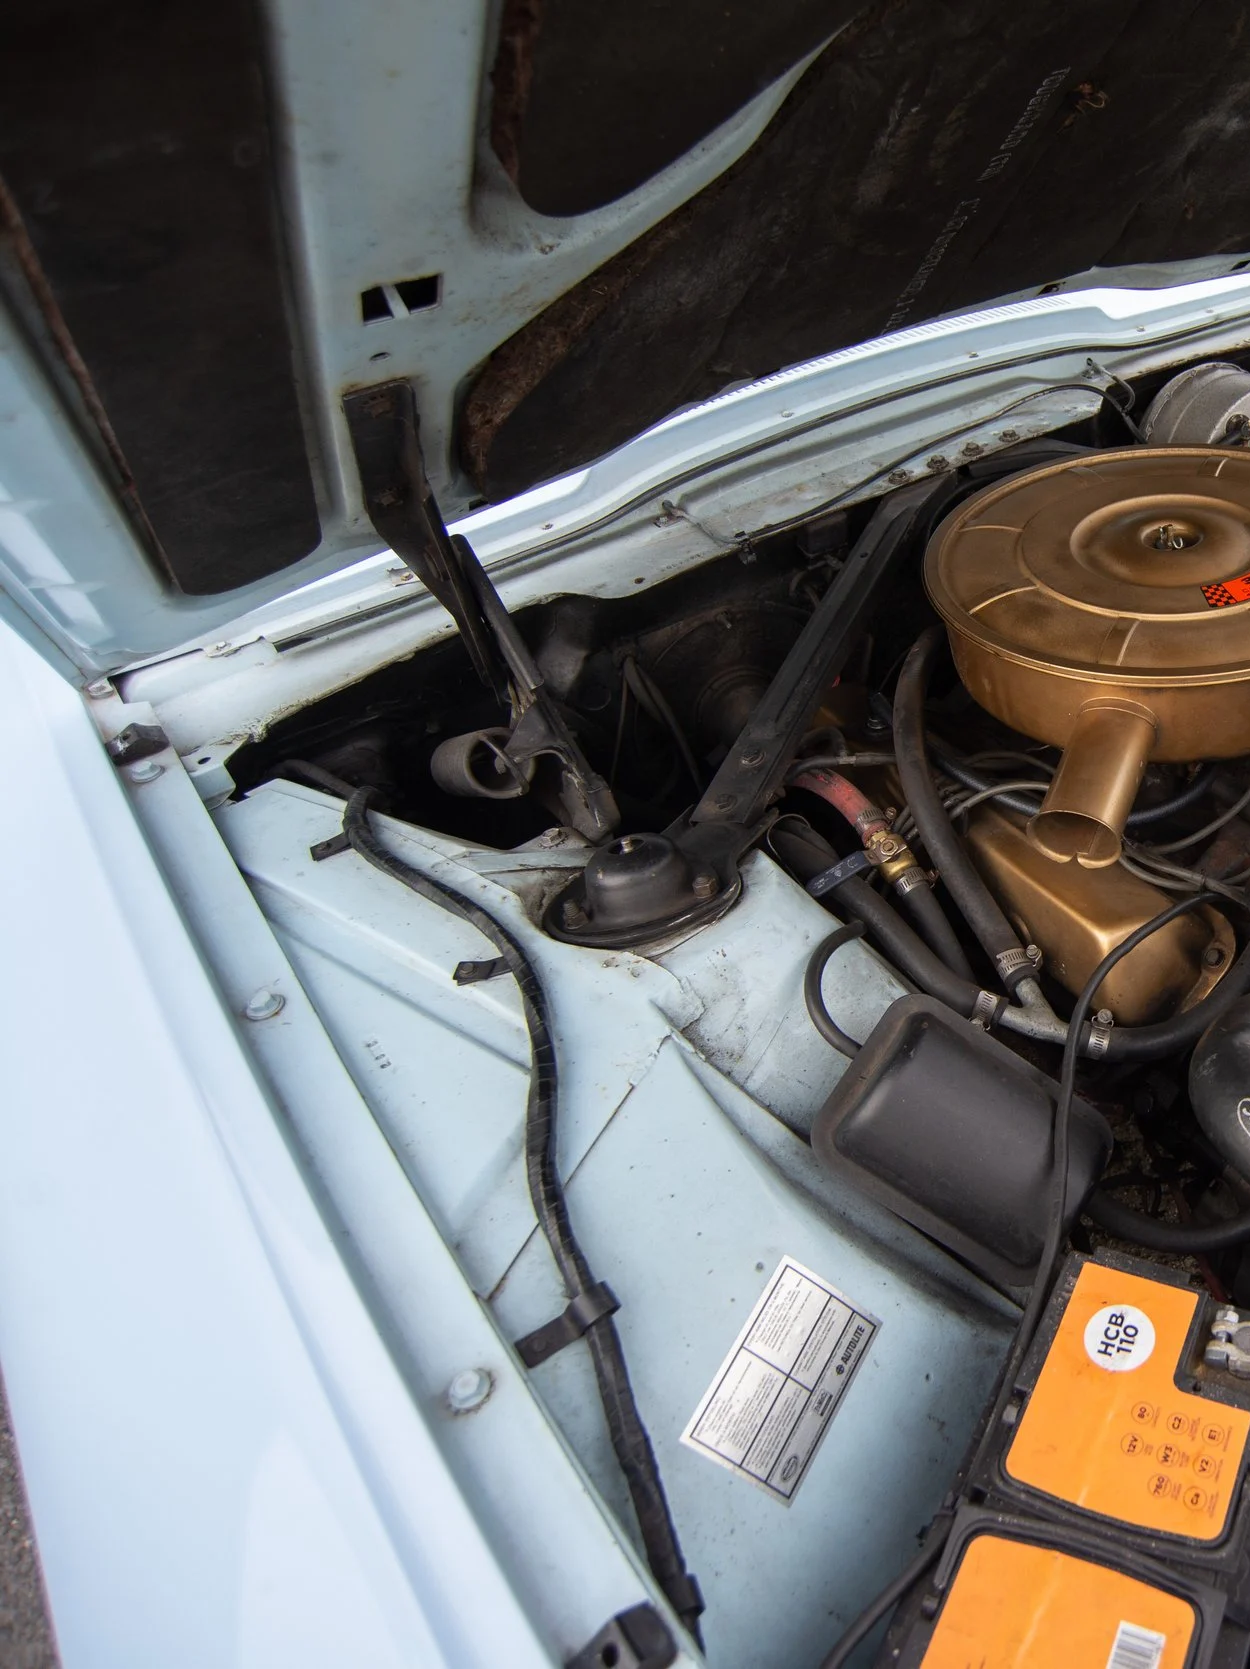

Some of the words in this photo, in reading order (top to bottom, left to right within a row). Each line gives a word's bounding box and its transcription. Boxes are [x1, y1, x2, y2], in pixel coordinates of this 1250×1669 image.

[841, 1325, 865, 1365] AUTOLITE
[1097, 1313, 1125, 1357] HCB
[1117, 1324, 1139, 1354] 110
[1127, 1435, 1139, 1453] 12V
[1154, 1477, 1165, 1495] 760
[1161, 1446, 1174, 1463] W3
[1172, 1416, 1182, 1430] C2
[1199, 1458, 1210, 1473] V2
[1208, 1429, 1218, 1440] E1
